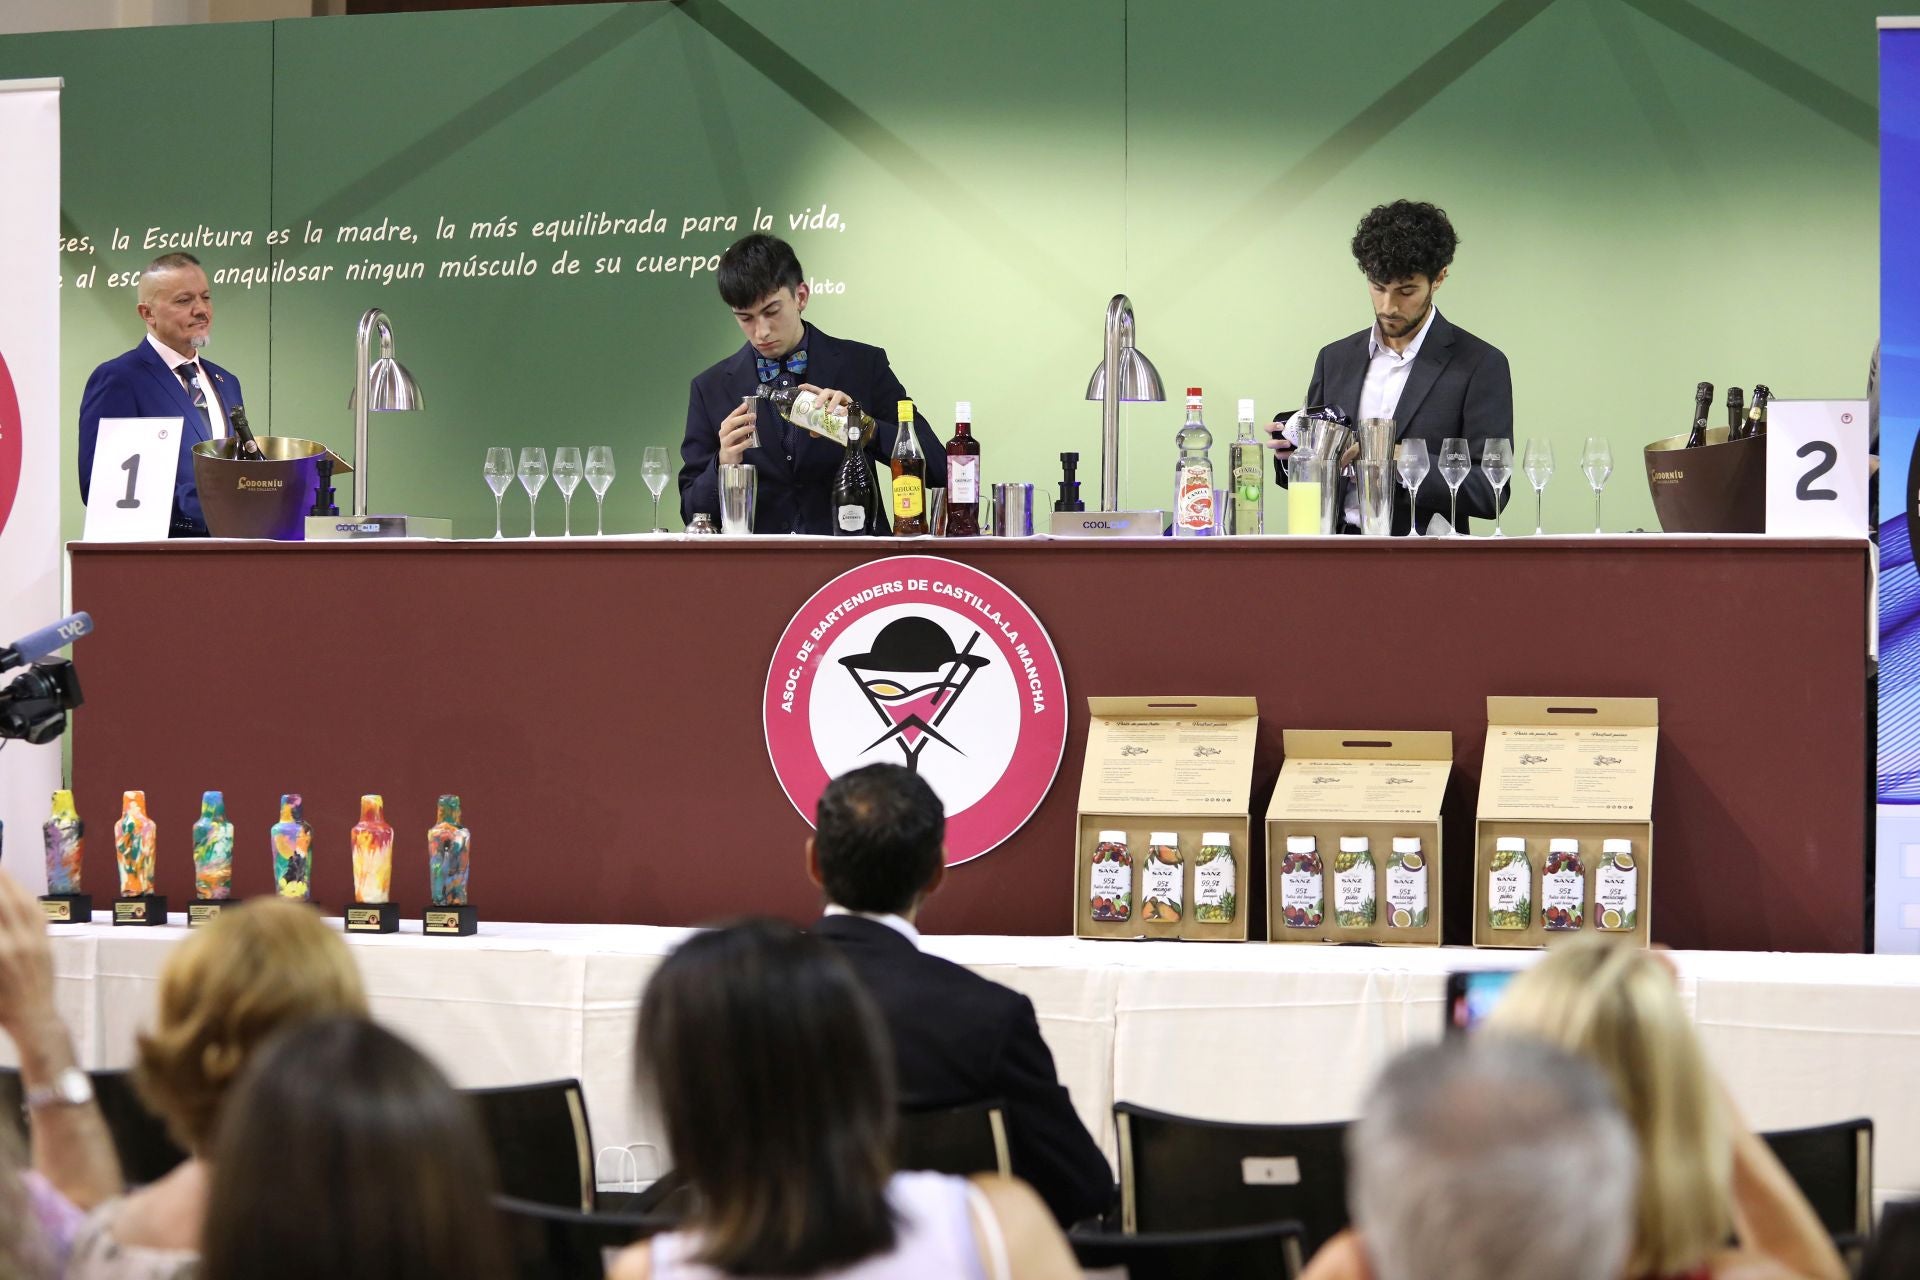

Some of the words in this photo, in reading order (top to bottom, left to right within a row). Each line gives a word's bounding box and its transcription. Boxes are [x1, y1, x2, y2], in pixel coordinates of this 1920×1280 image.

[58, 233, 95, 255] tes,
[111, 227, 130, 251] la
[143, 224, 253, 250] Escultura
[266, 228, 291, 245] es
[303, 220, 323, 244] la
[337, 216, 418, 245] madre,
[435, 216, 456, 240] la
[469, 215, 518, 240] más
[532, 209, 667, 243] equilibrada
[681, 215, 738, 240] para
[752, 207, 774, 231] la
[788, 204, 847, 233] vida,
[76, 265, 97, 289] al
[107, 271, 141, 289] esc
[213, 259, 334, 290] anquilosar
[345, 259, 425, 287] ningun
[438, 251, 538, 279] músculo
[551, 249, 581, 275] de
[594, 256, 622, 274] su
[635, 254, 721, 279] cuerpo
[809, 277, 847, 296] lato
[116, 453, 141, 509] 1
[1796, 440, 1838, 501] 2
[781, 665, 804, 714] ASOC.
[799, 639, 816, 663] DE
[810, 579, 904, 639] BARTENDERS
[907, 579, 929, 591] DE
[932, 580, 1018, 645] CASTILLA-LA
[1015, 643, 1046, 715] MANCHA
